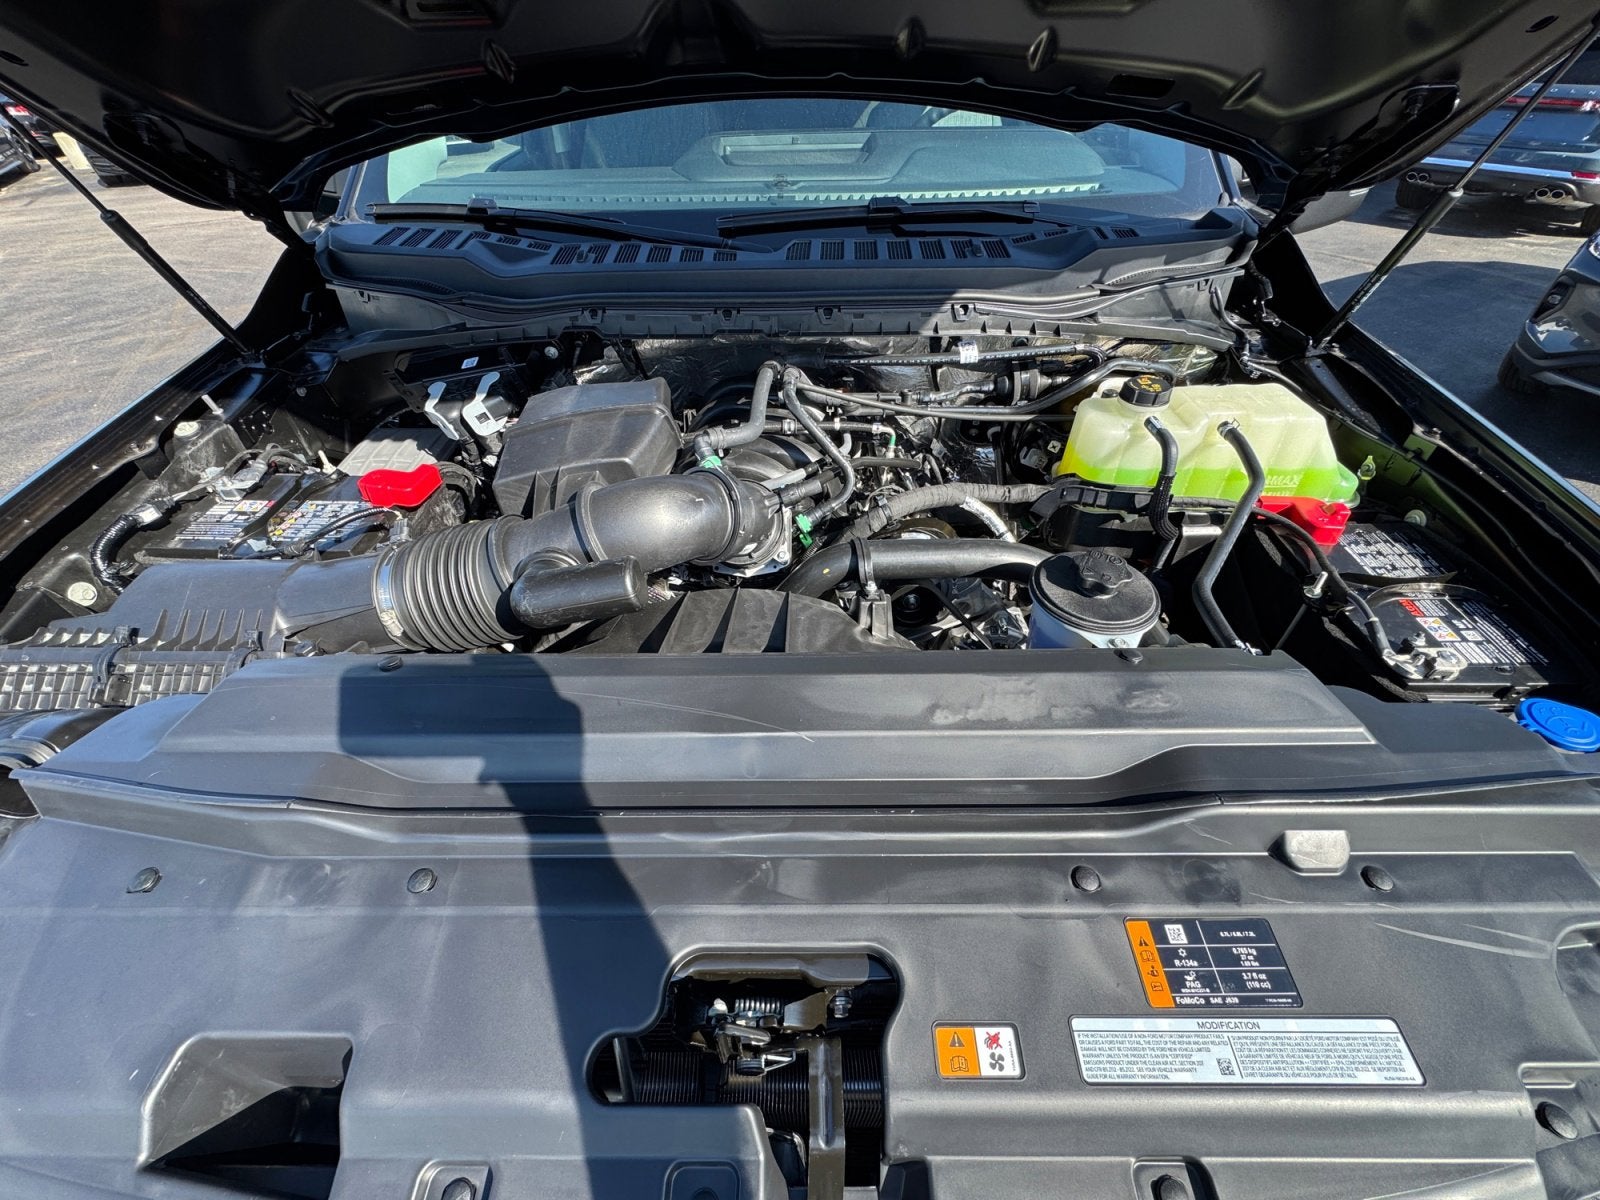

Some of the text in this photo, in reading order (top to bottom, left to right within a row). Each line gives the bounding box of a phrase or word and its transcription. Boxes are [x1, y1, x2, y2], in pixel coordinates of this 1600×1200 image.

[1248, 948, 1257, 956] kg
[1246, 981, 1272, 989] (110 cc)
[1175, 996, 1205, 1004] FoMoCo
[1197, 1021, 1261, 1031] MODIFICATION
